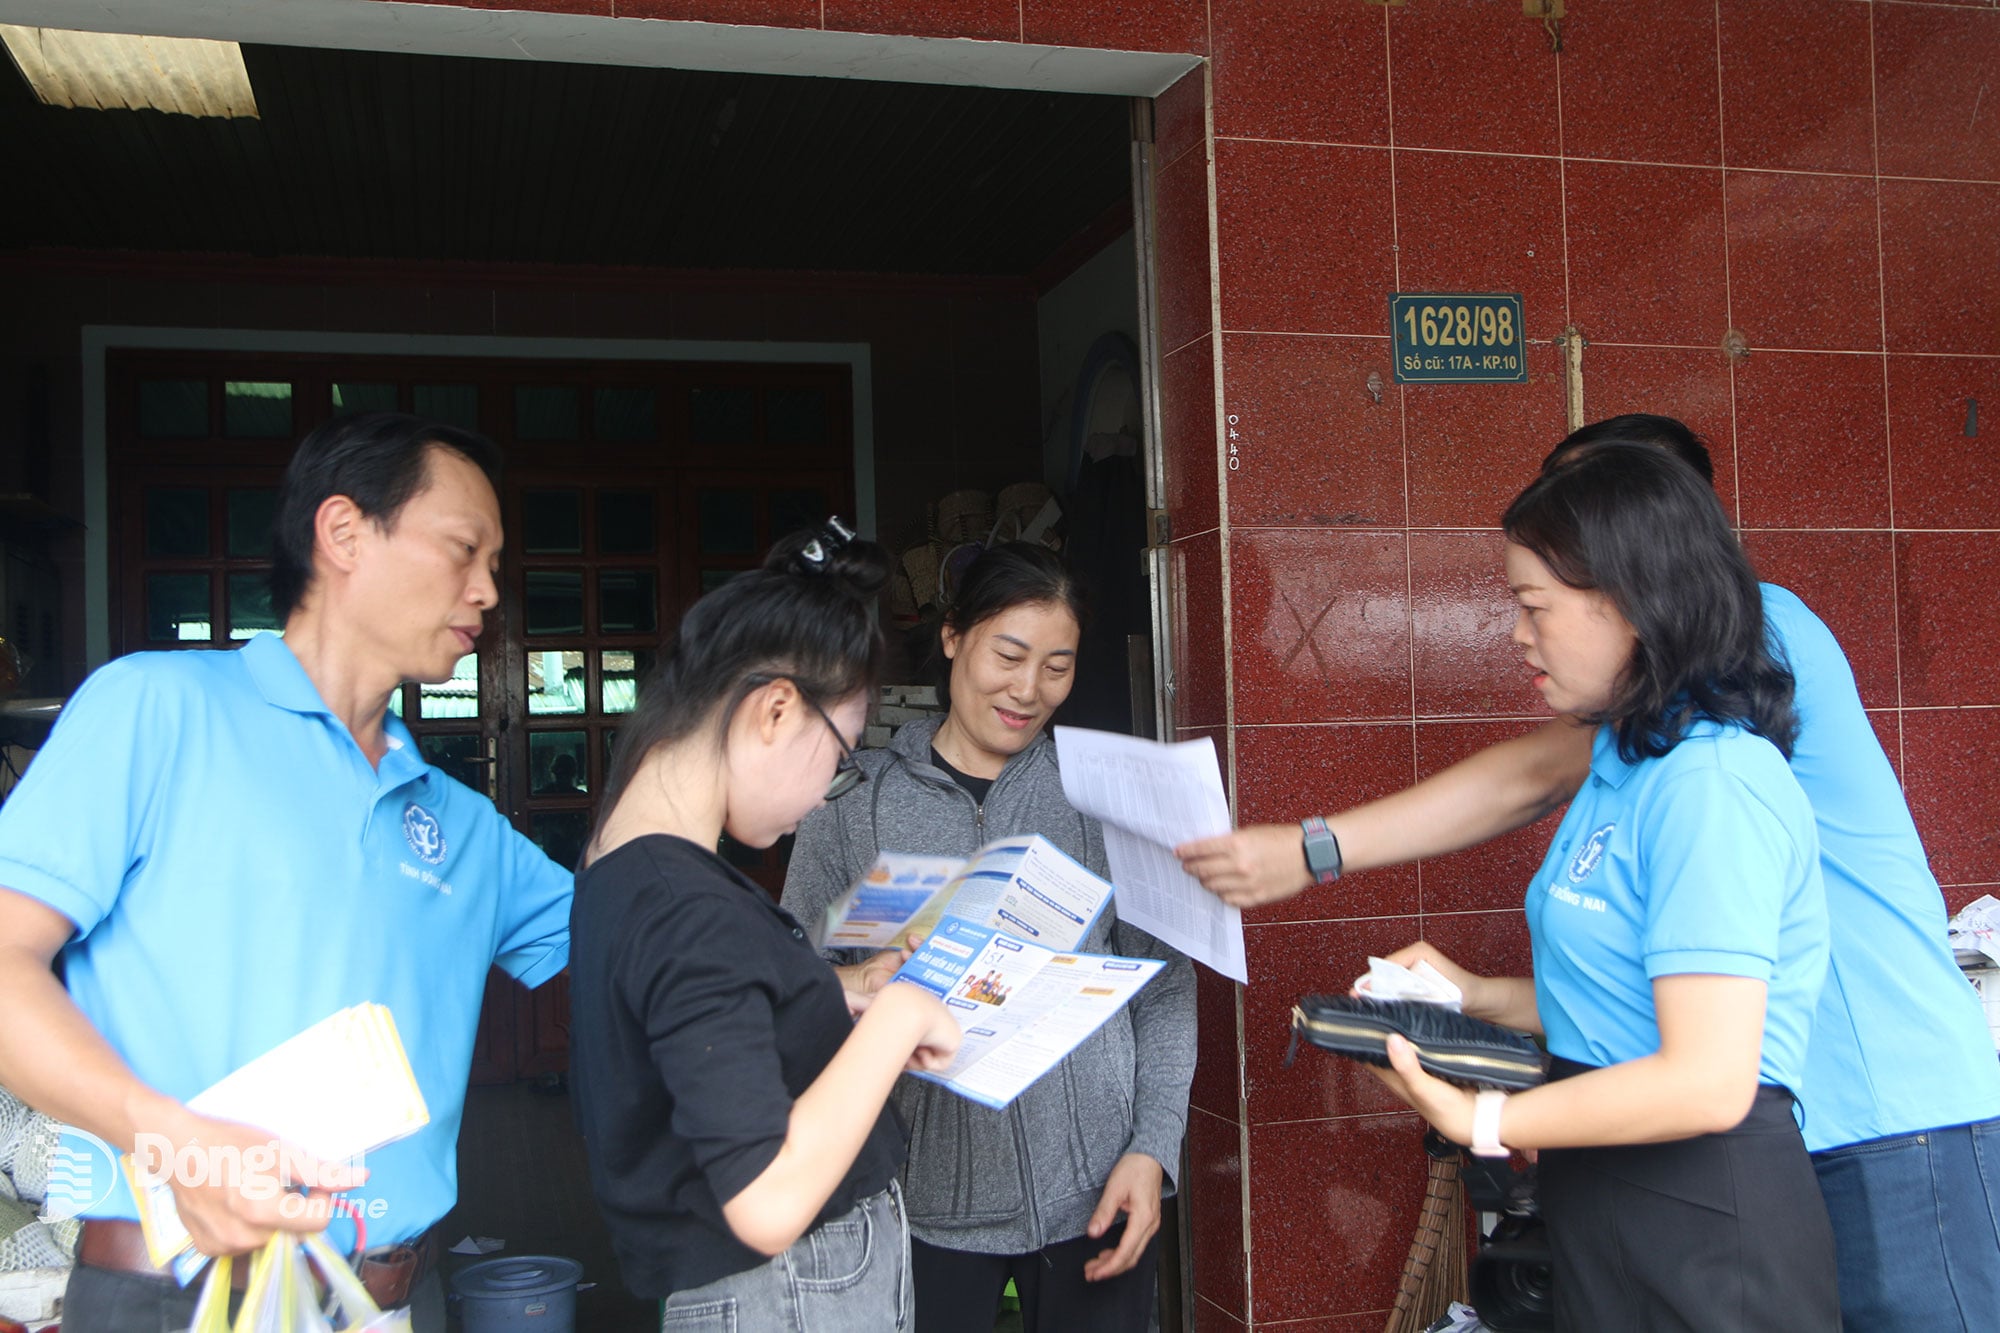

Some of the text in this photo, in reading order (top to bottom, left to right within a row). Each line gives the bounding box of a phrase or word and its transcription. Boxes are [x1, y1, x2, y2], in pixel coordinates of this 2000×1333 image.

[1404, 305, 1514, 347] 1628/98
[1403, 352, 1422, 370] Số
[1425, 355, 1445, 370] cũ:
[1448, 355, 1473, 369] 17A
[1482, 355, 1517, 369] KP.10
[1583, 895, 1606, 913] NAI
